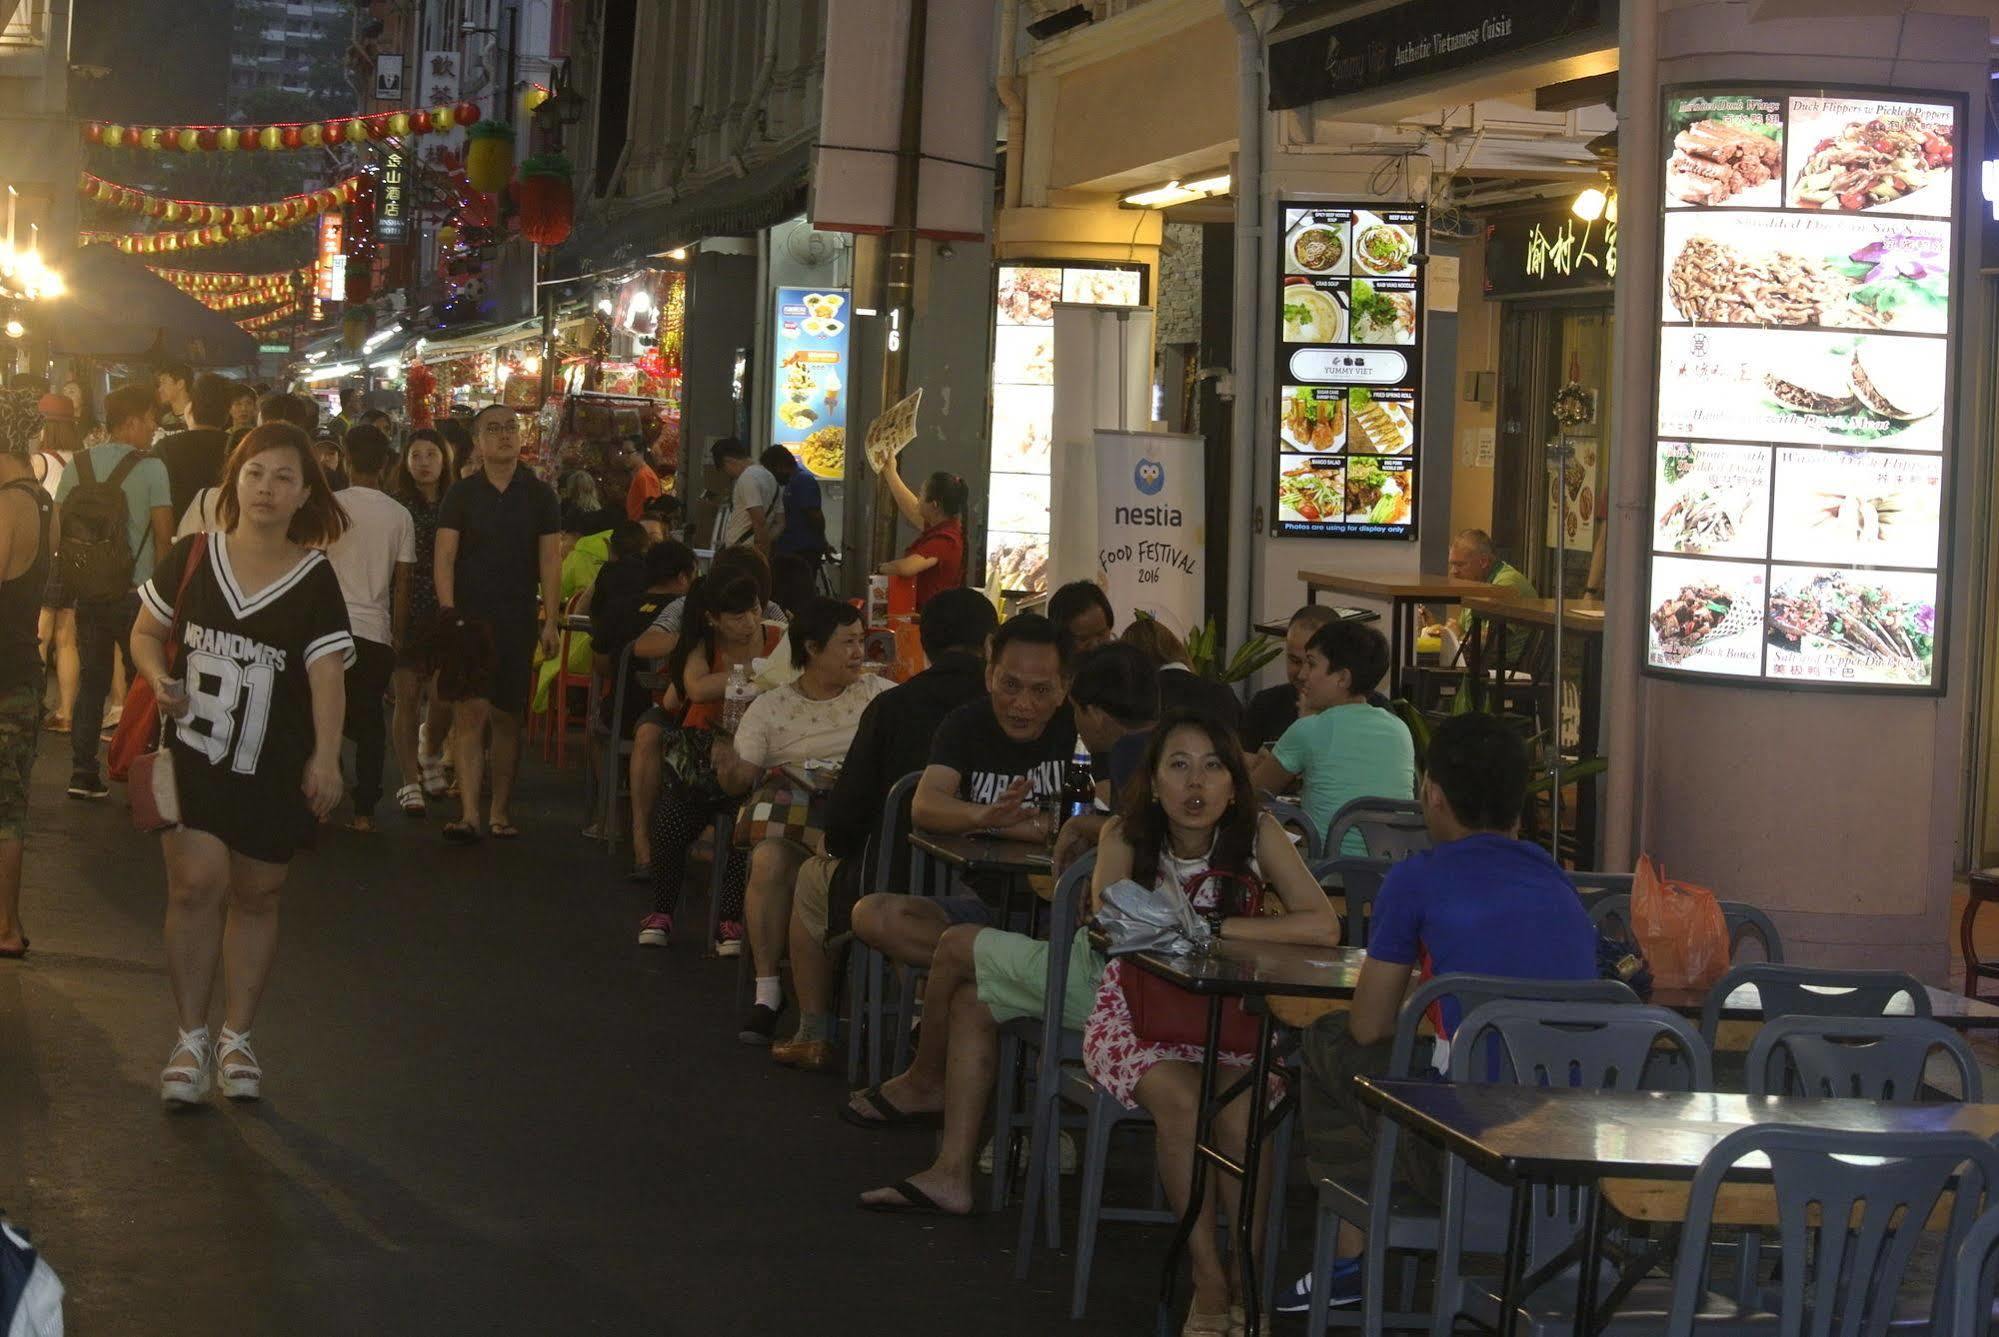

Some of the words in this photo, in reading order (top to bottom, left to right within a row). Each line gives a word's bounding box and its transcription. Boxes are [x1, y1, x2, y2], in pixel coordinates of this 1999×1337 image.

[1394, 37, 1431, 66] Authentic
[1433, 28, 1480, 55] Vietnamese
[1792, 101, 1819, 111] Duck
[1822, 101, 1861, 114] Flippers
[1876, 104, 1911, 117] Pickled
[1914, 106, 1951, 120] Peppers
[1325, 367, 1353, 376] YUMMY
[1355, 368, 1373, 376] VIET
[1115, 503, 1183, 528] nestia
[1326, 524, 1346, 532] using
[1359, 524, 1386, 533] display
[1099, 545, 1133, 573] FOOD
[1138, 540, 1196, 575] FESTIVAL
[1138, 567, 1160, 583] 2016
[1726, 647, 1758, 660] Bones
[1774, 651, 1796, 663] Salt
[1824, 654, 1862, 668] Pepper
[174, 650, 275, 775] 81
